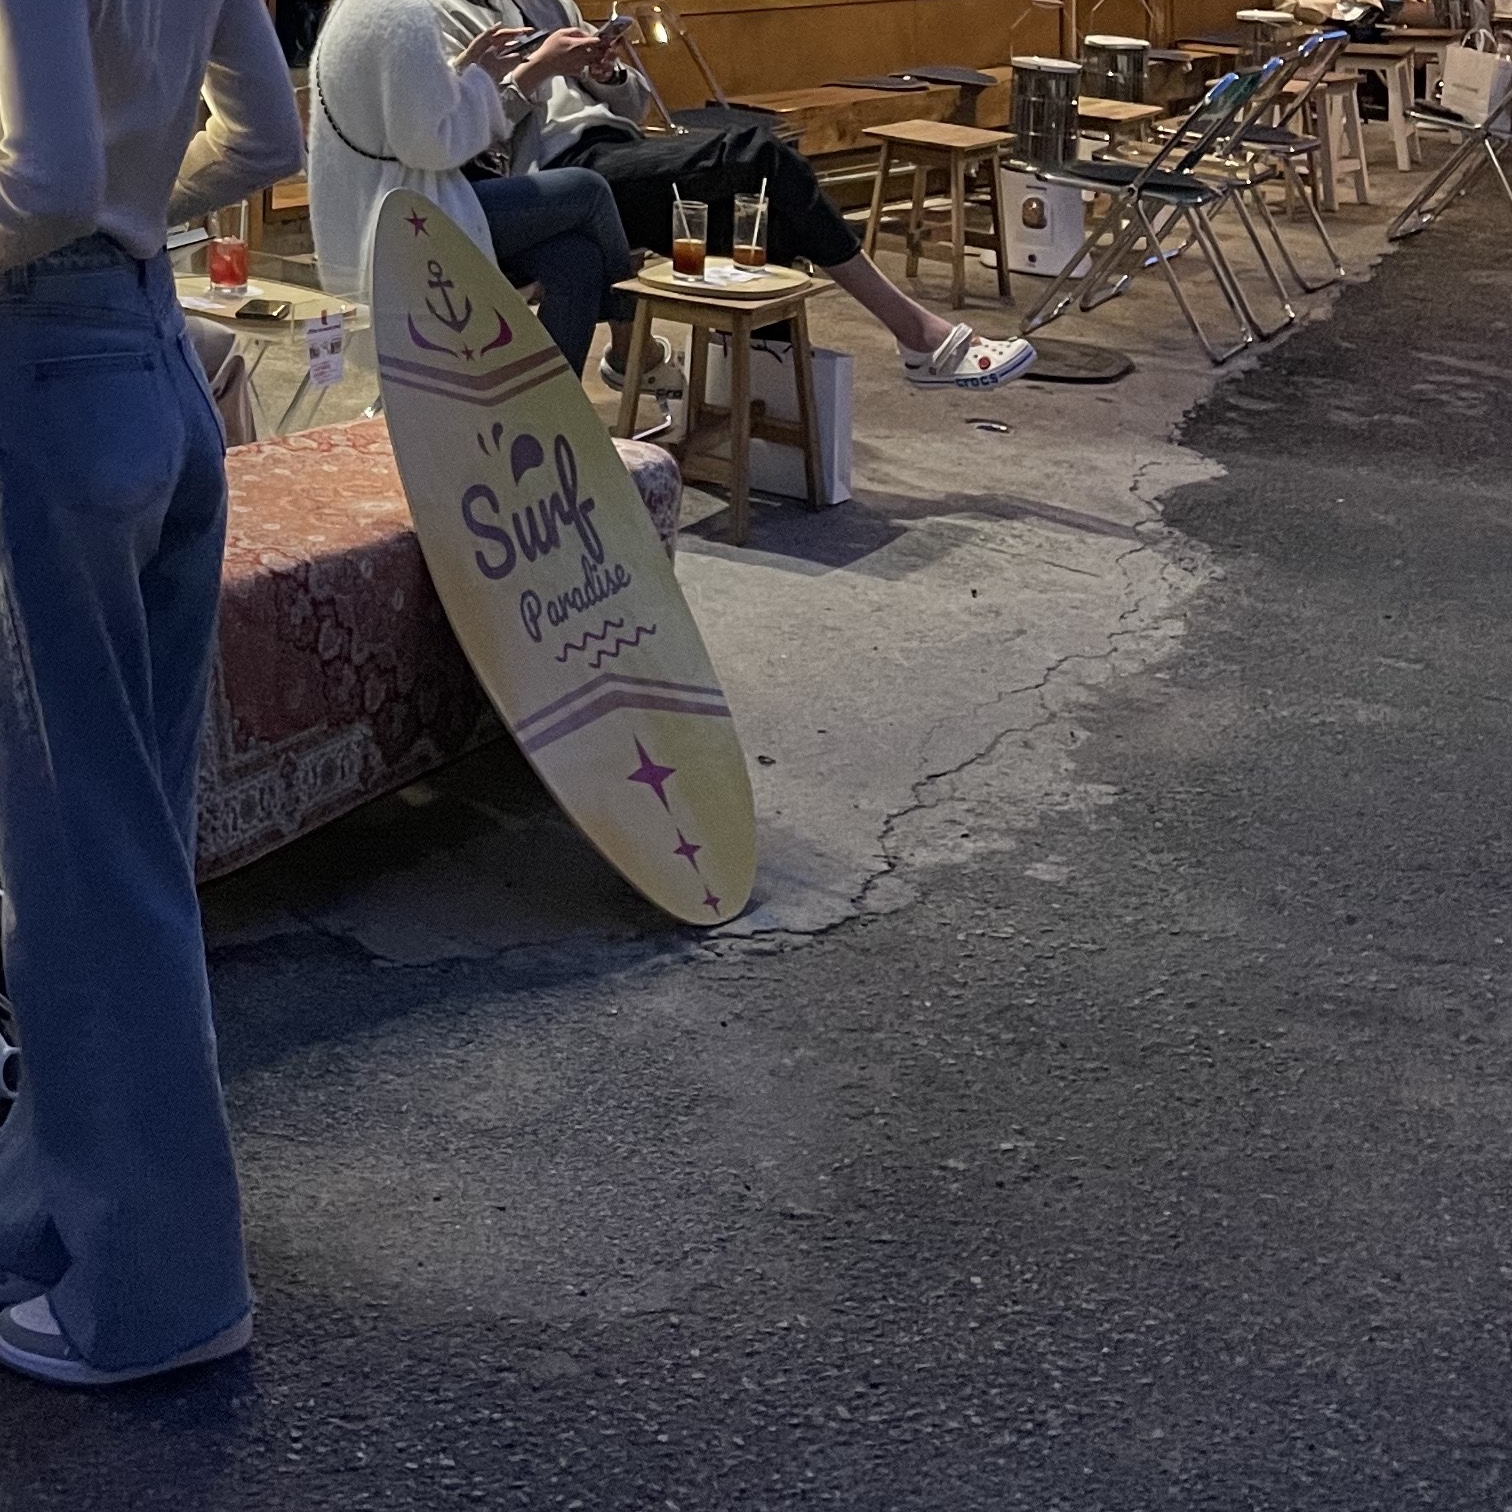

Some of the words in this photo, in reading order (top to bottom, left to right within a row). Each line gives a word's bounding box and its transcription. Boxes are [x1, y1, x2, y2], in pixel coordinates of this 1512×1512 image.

[955, 373, 999, 388] crocs
[461, 433, 605, 580] Surf
[520, 552, 631, 643] Paradise
